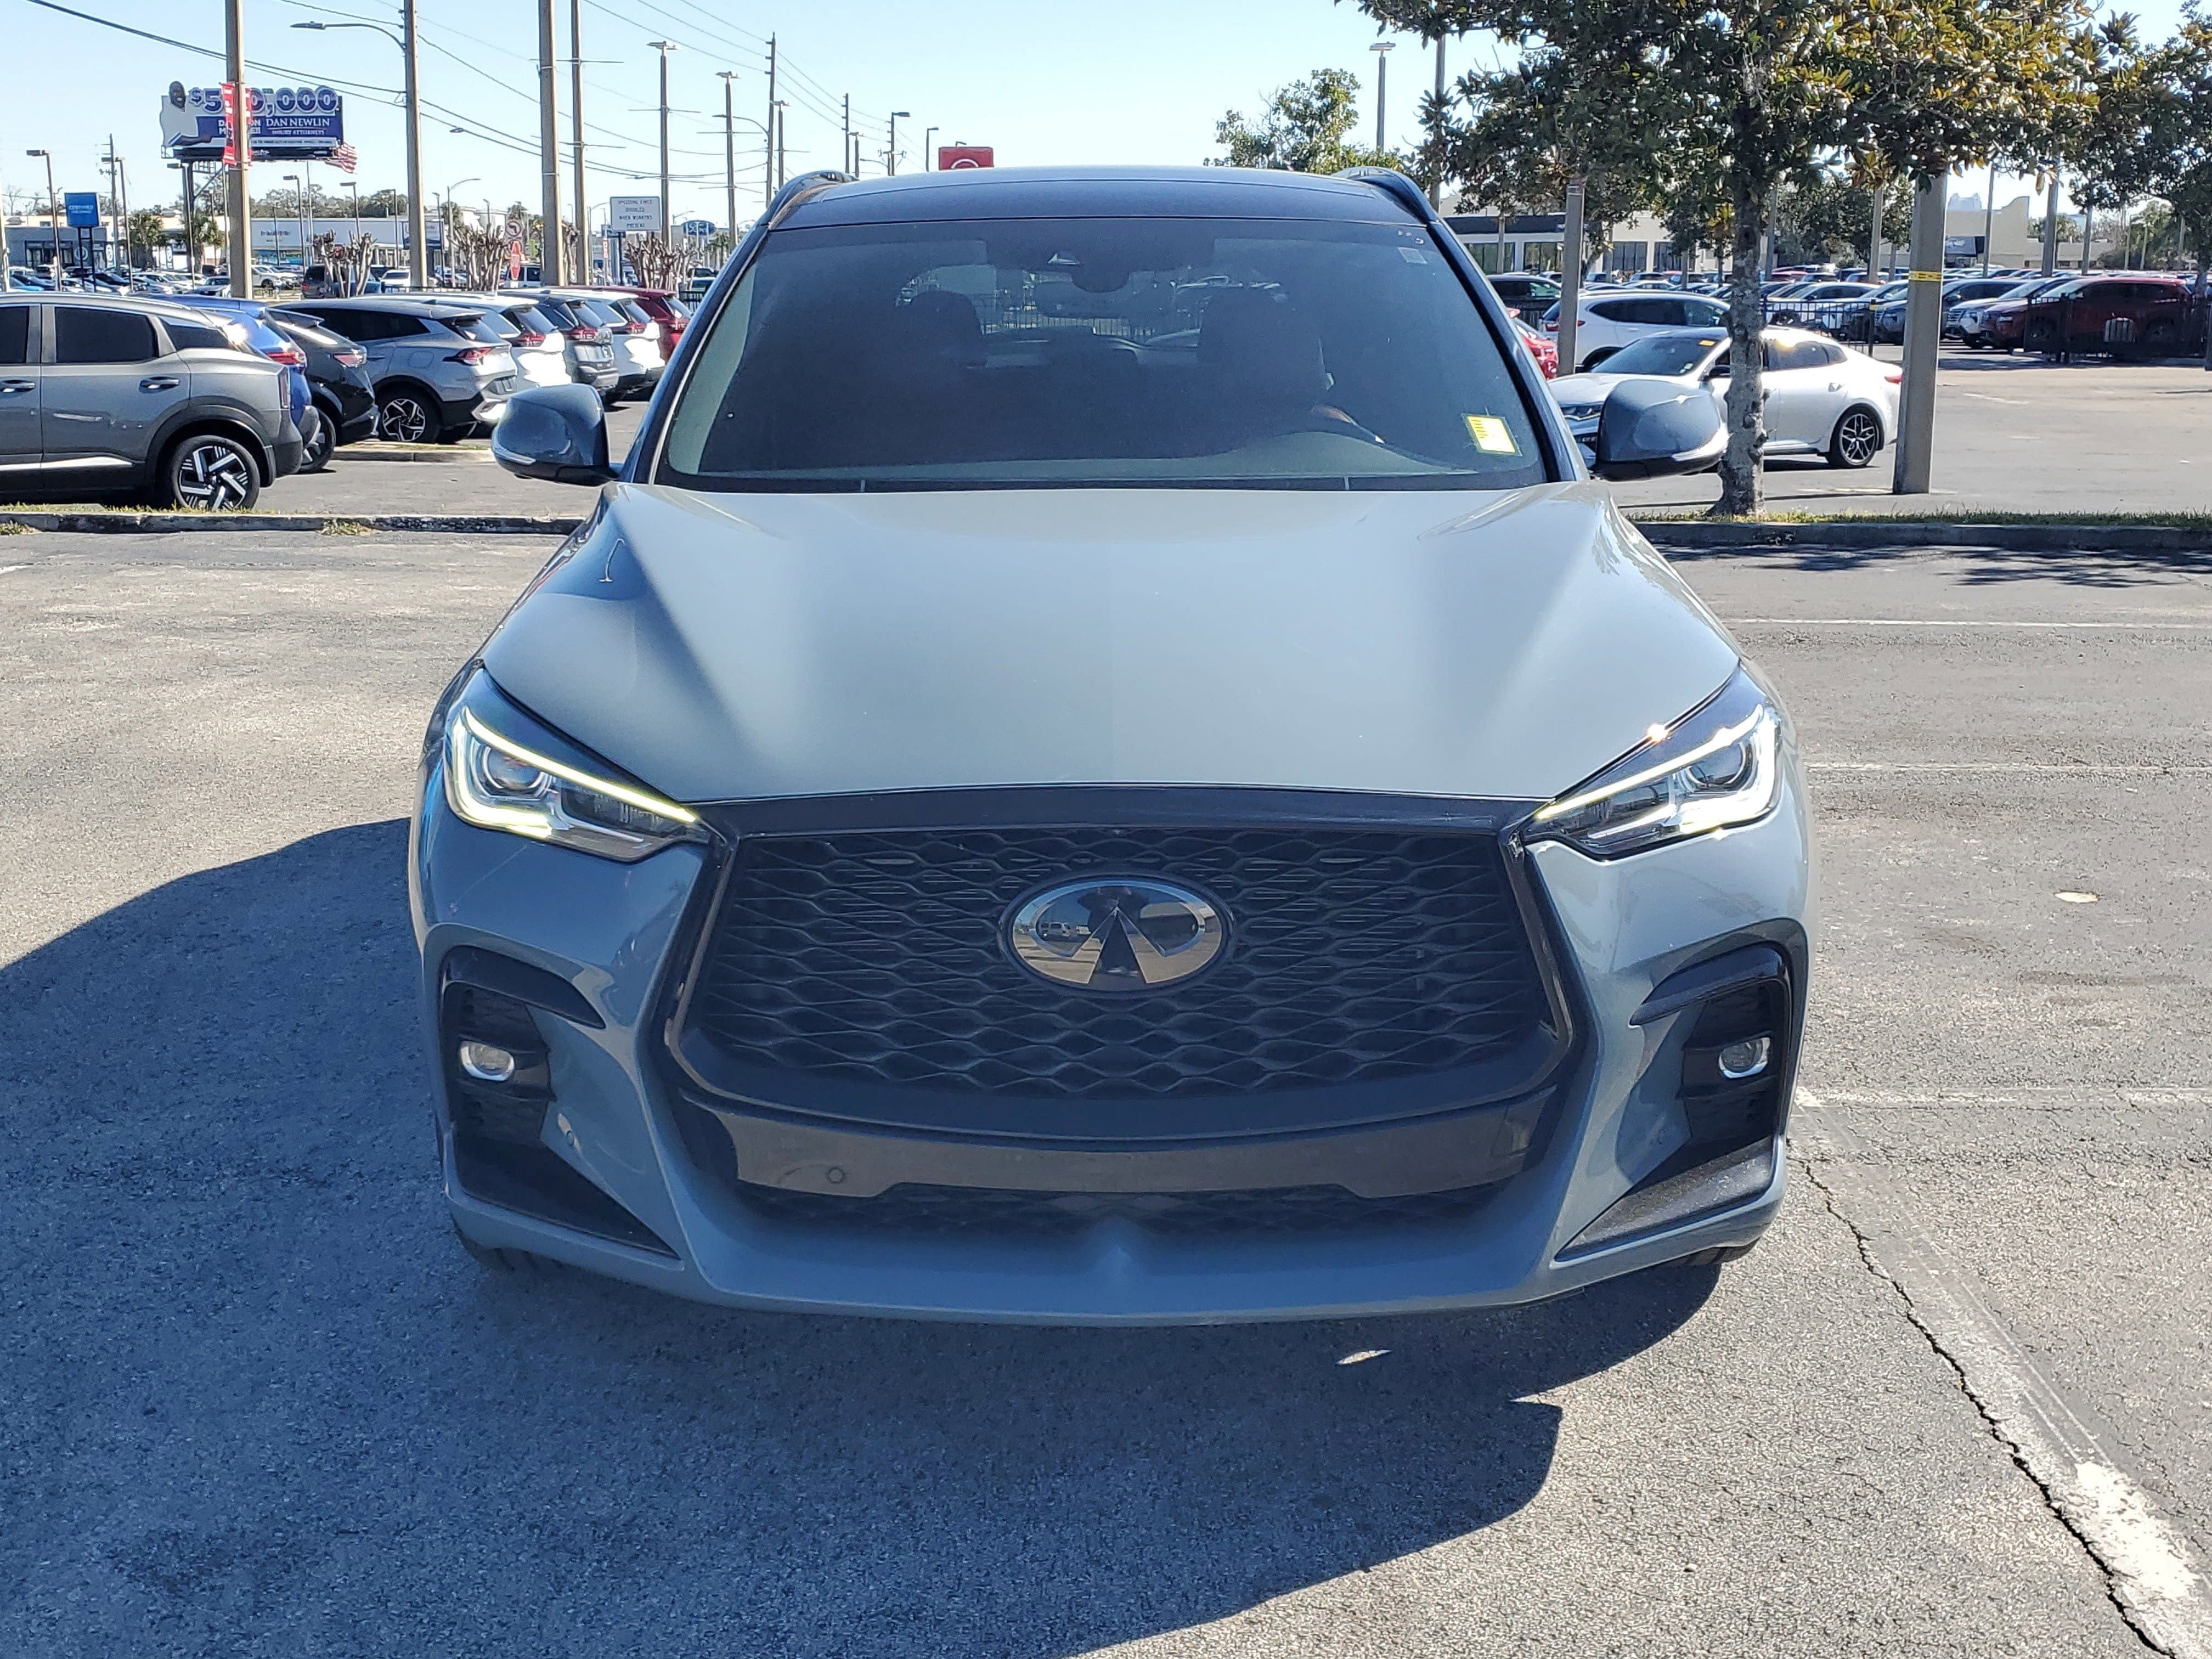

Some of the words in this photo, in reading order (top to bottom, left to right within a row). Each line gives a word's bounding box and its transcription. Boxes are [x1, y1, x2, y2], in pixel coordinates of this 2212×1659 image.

[189, 89, 338, 117] $50,000
[266, 118, 287, 127] DAN
[290, 118, 330, 127] NEWLIN
